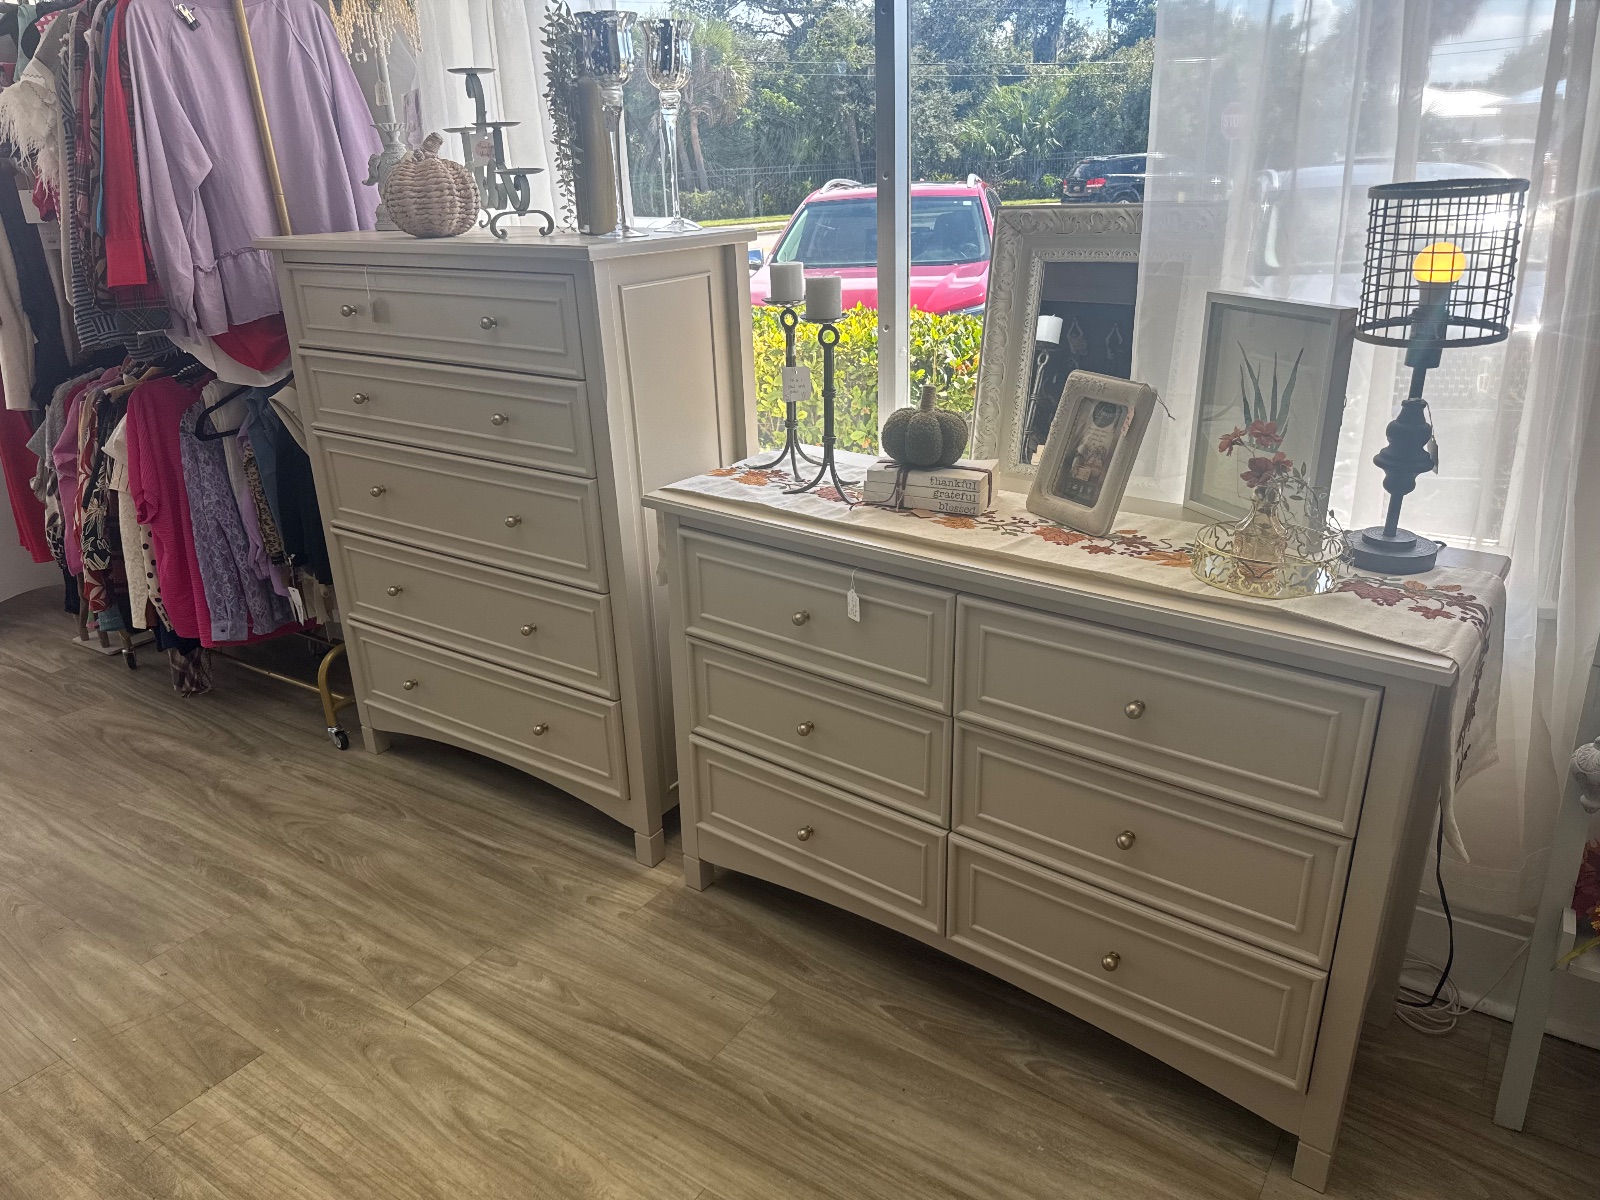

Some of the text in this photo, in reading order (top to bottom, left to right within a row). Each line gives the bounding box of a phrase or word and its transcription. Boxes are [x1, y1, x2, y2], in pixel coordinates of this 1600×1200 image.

[930, 476, 977, 490] thankful
[933, 490, 977, 503] grateful
[939, 502, 976, 515] blessed
